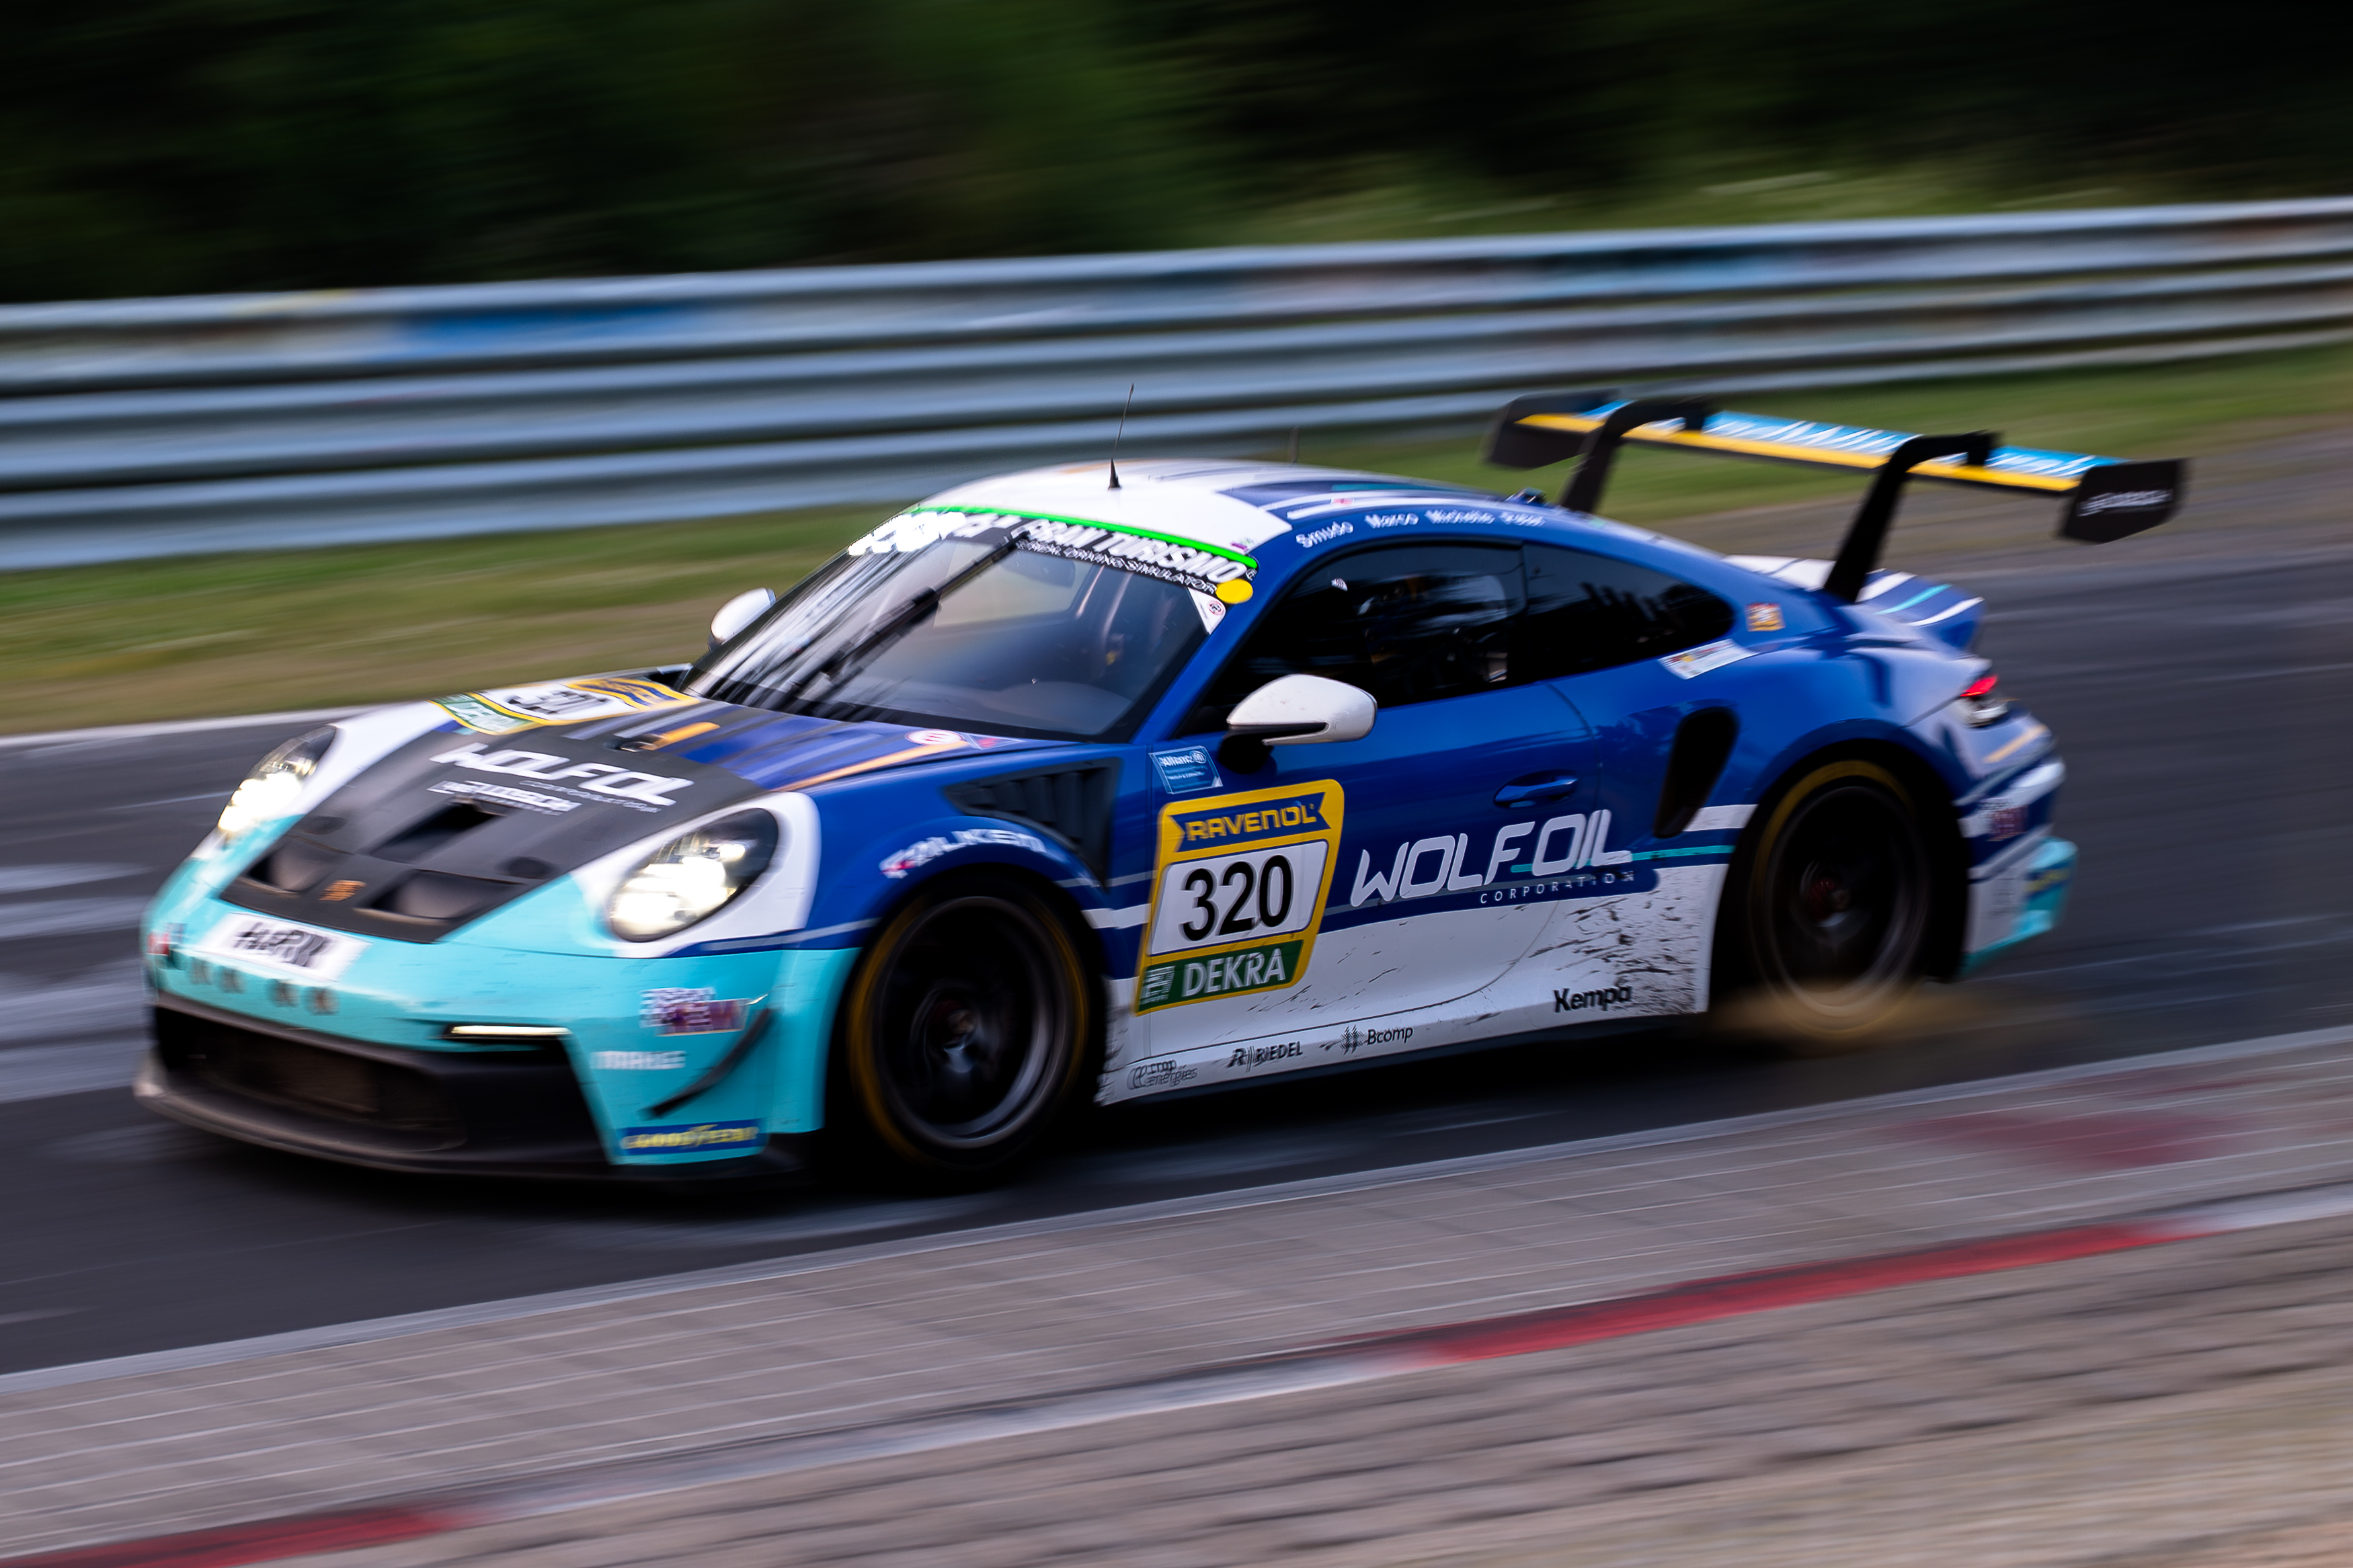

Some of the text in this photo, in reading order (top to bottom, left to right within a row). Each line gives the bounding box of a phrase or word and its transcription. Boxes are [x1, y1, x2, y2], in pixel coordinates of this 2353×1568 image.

[1093, 530, 1247, 583] TURISMO
[1185, 805, 1317, 841] RAVENOL
[1179, 854, 1294, 942] 320
[1181, 948, 1287, 998] DEKRA
[1553, 985, 1632, 1013] Kempa
[1254, 1041, 1304, 1067] RIEDEL
[1367, 1027, 1414, 1045] Bcomp
